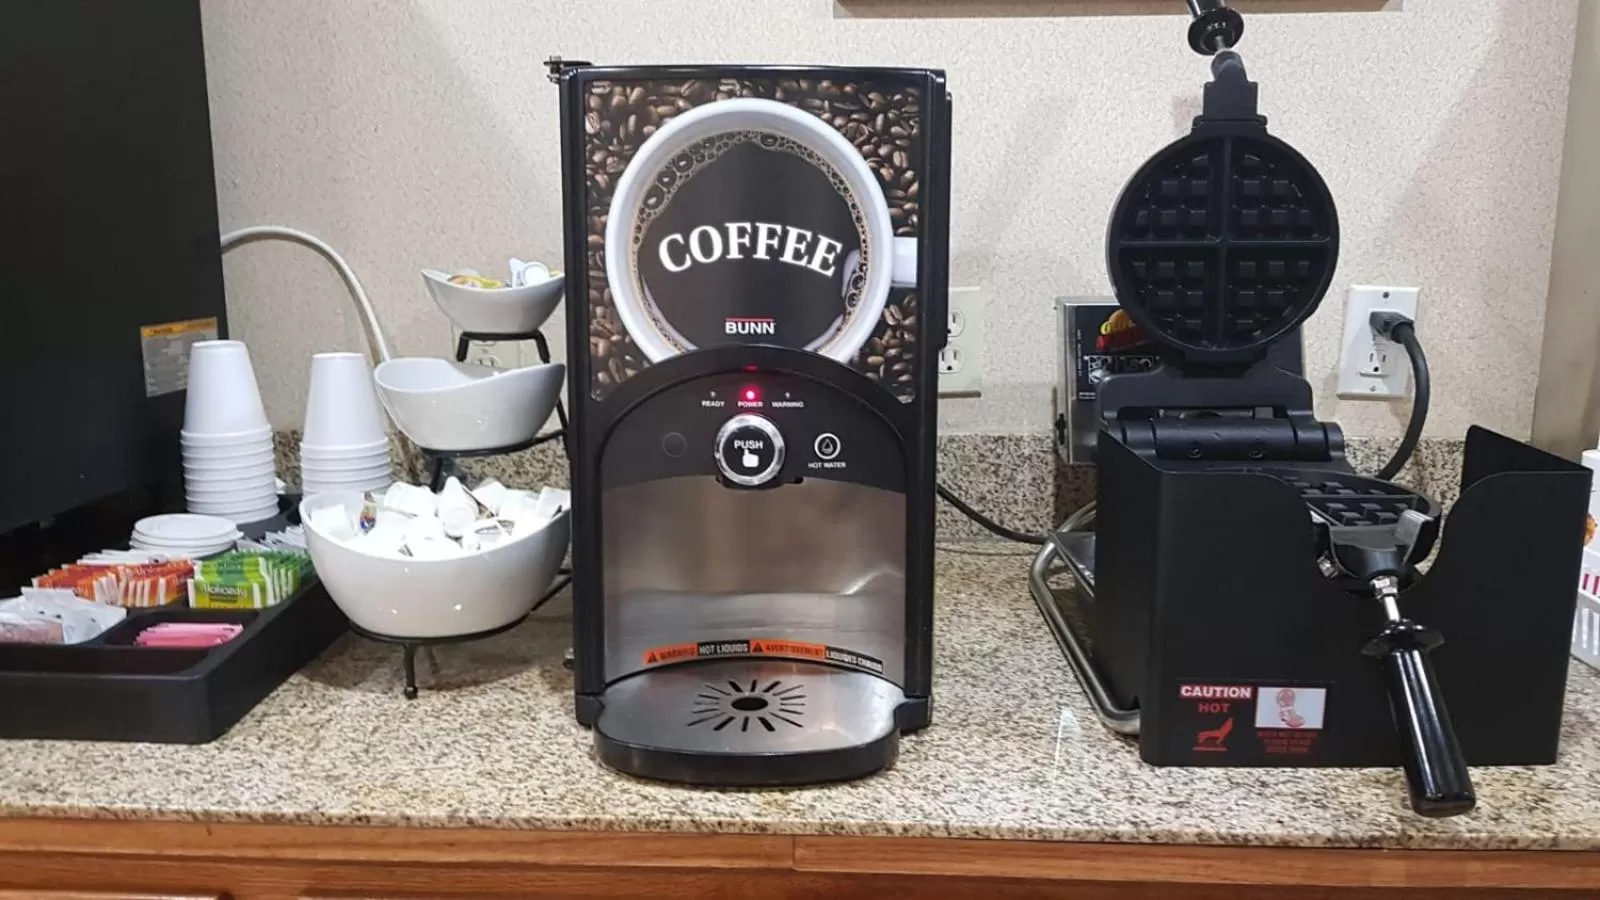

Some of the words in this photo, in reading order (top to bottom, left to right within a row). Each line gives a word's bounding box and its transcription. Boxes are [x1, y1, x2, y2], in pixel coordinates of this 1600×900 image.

[658, 222, 843, 277] COFFEE
[725, 321, 775, 334] BUNN
[734, 439, 764, 449] PUSH
[699, 645, 714, 654] HOT
[716, 643, 748, 653] LIQUIDS
[1180, 685, 1251, 699] CAUTION
[1198, 703, 1231, 713] HOT
